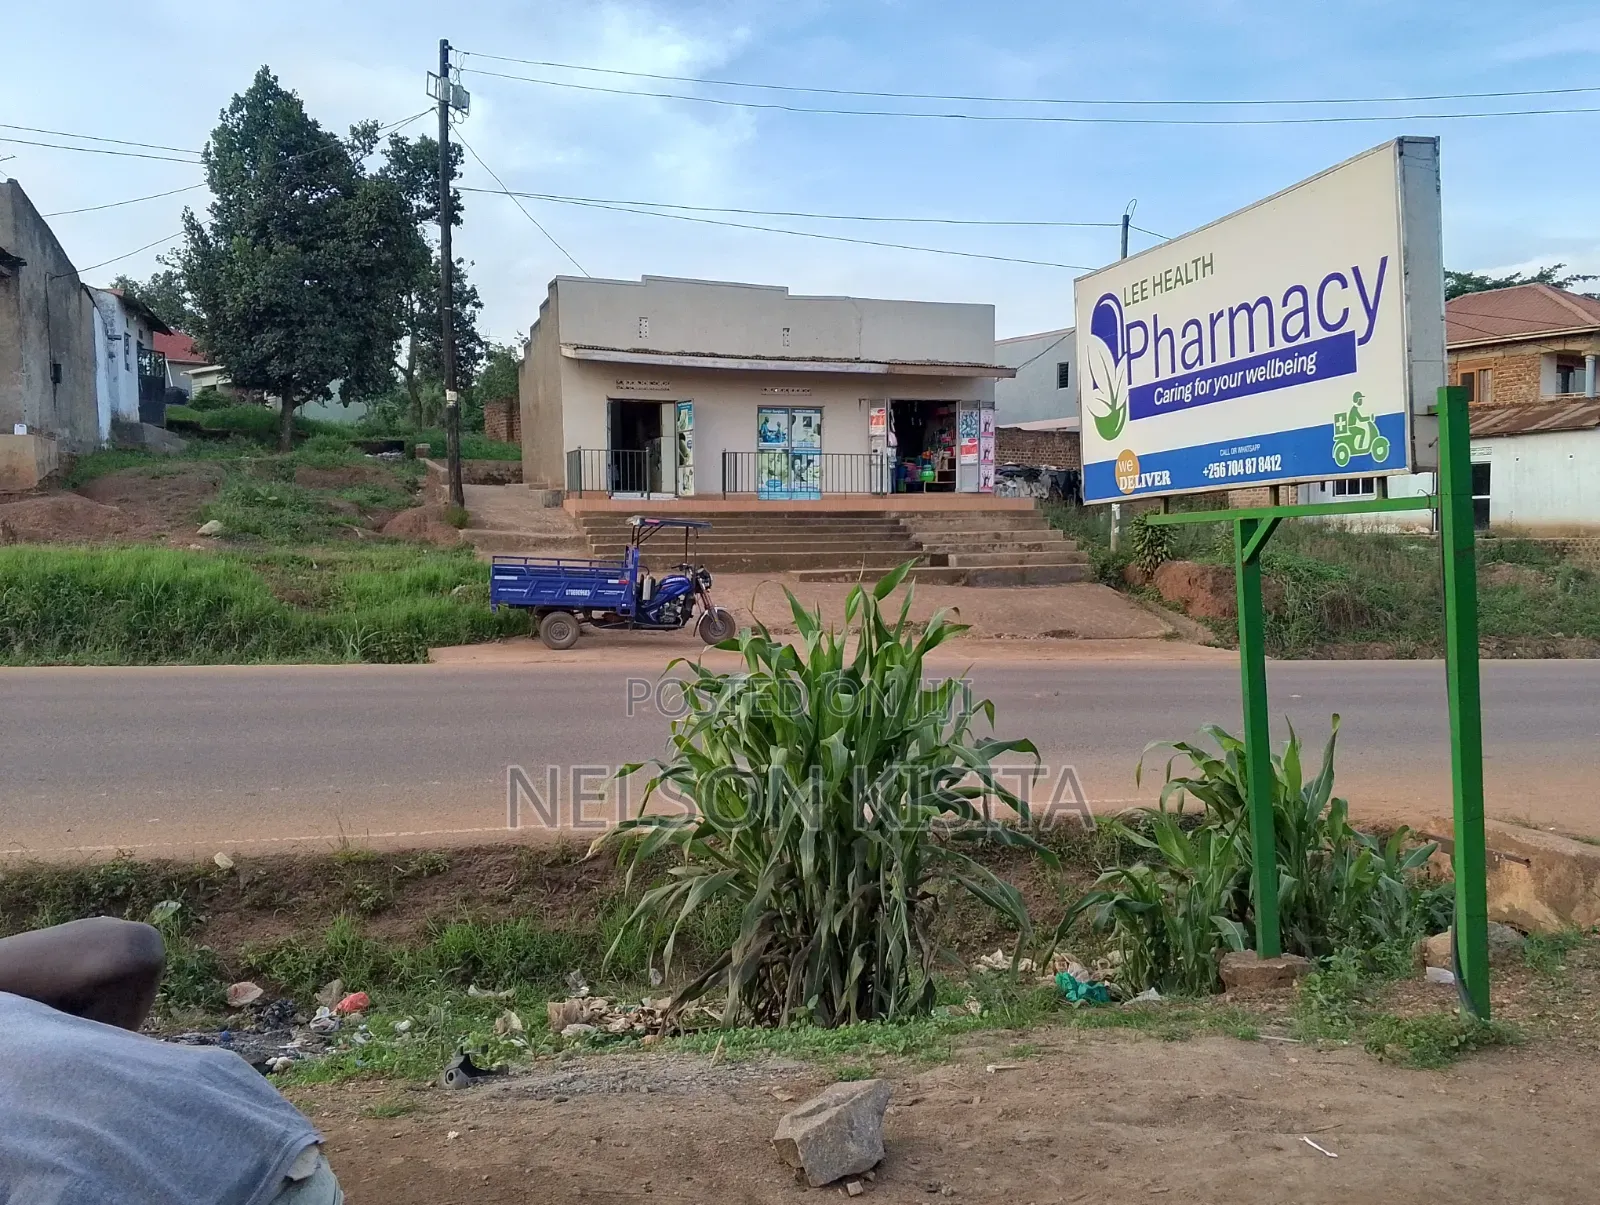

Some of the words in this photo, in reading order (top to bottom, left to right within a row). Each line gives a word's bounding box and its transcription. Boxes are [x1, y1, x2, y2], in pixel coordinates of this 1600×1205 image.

[1123, 279, 1148, 307] LEE
[1152, 252, 1214, 297] HEALTH
[1125, 255, 1389, 386] Pharmacy
[1154, 382, 1192, 406] Caring
[1194, 377, 1212, 397] for
[1213, 370, 1244, 397] your
[1245, 351, 1318, 384] wellbeing
[1202, 462, 1226, 479] +256
[1227, 459, 1244, 477] 704
[1245, 457, 1258, 475] 87
[1258, 453, 1282, 473] 8412
[1219, 449, 1230, 457] CALL
[1231, 447, 1238, 455] OR
[1237, 443, 1261, 454] WHATSAPP
[1119, 470, 1172, 491] DELIVER
